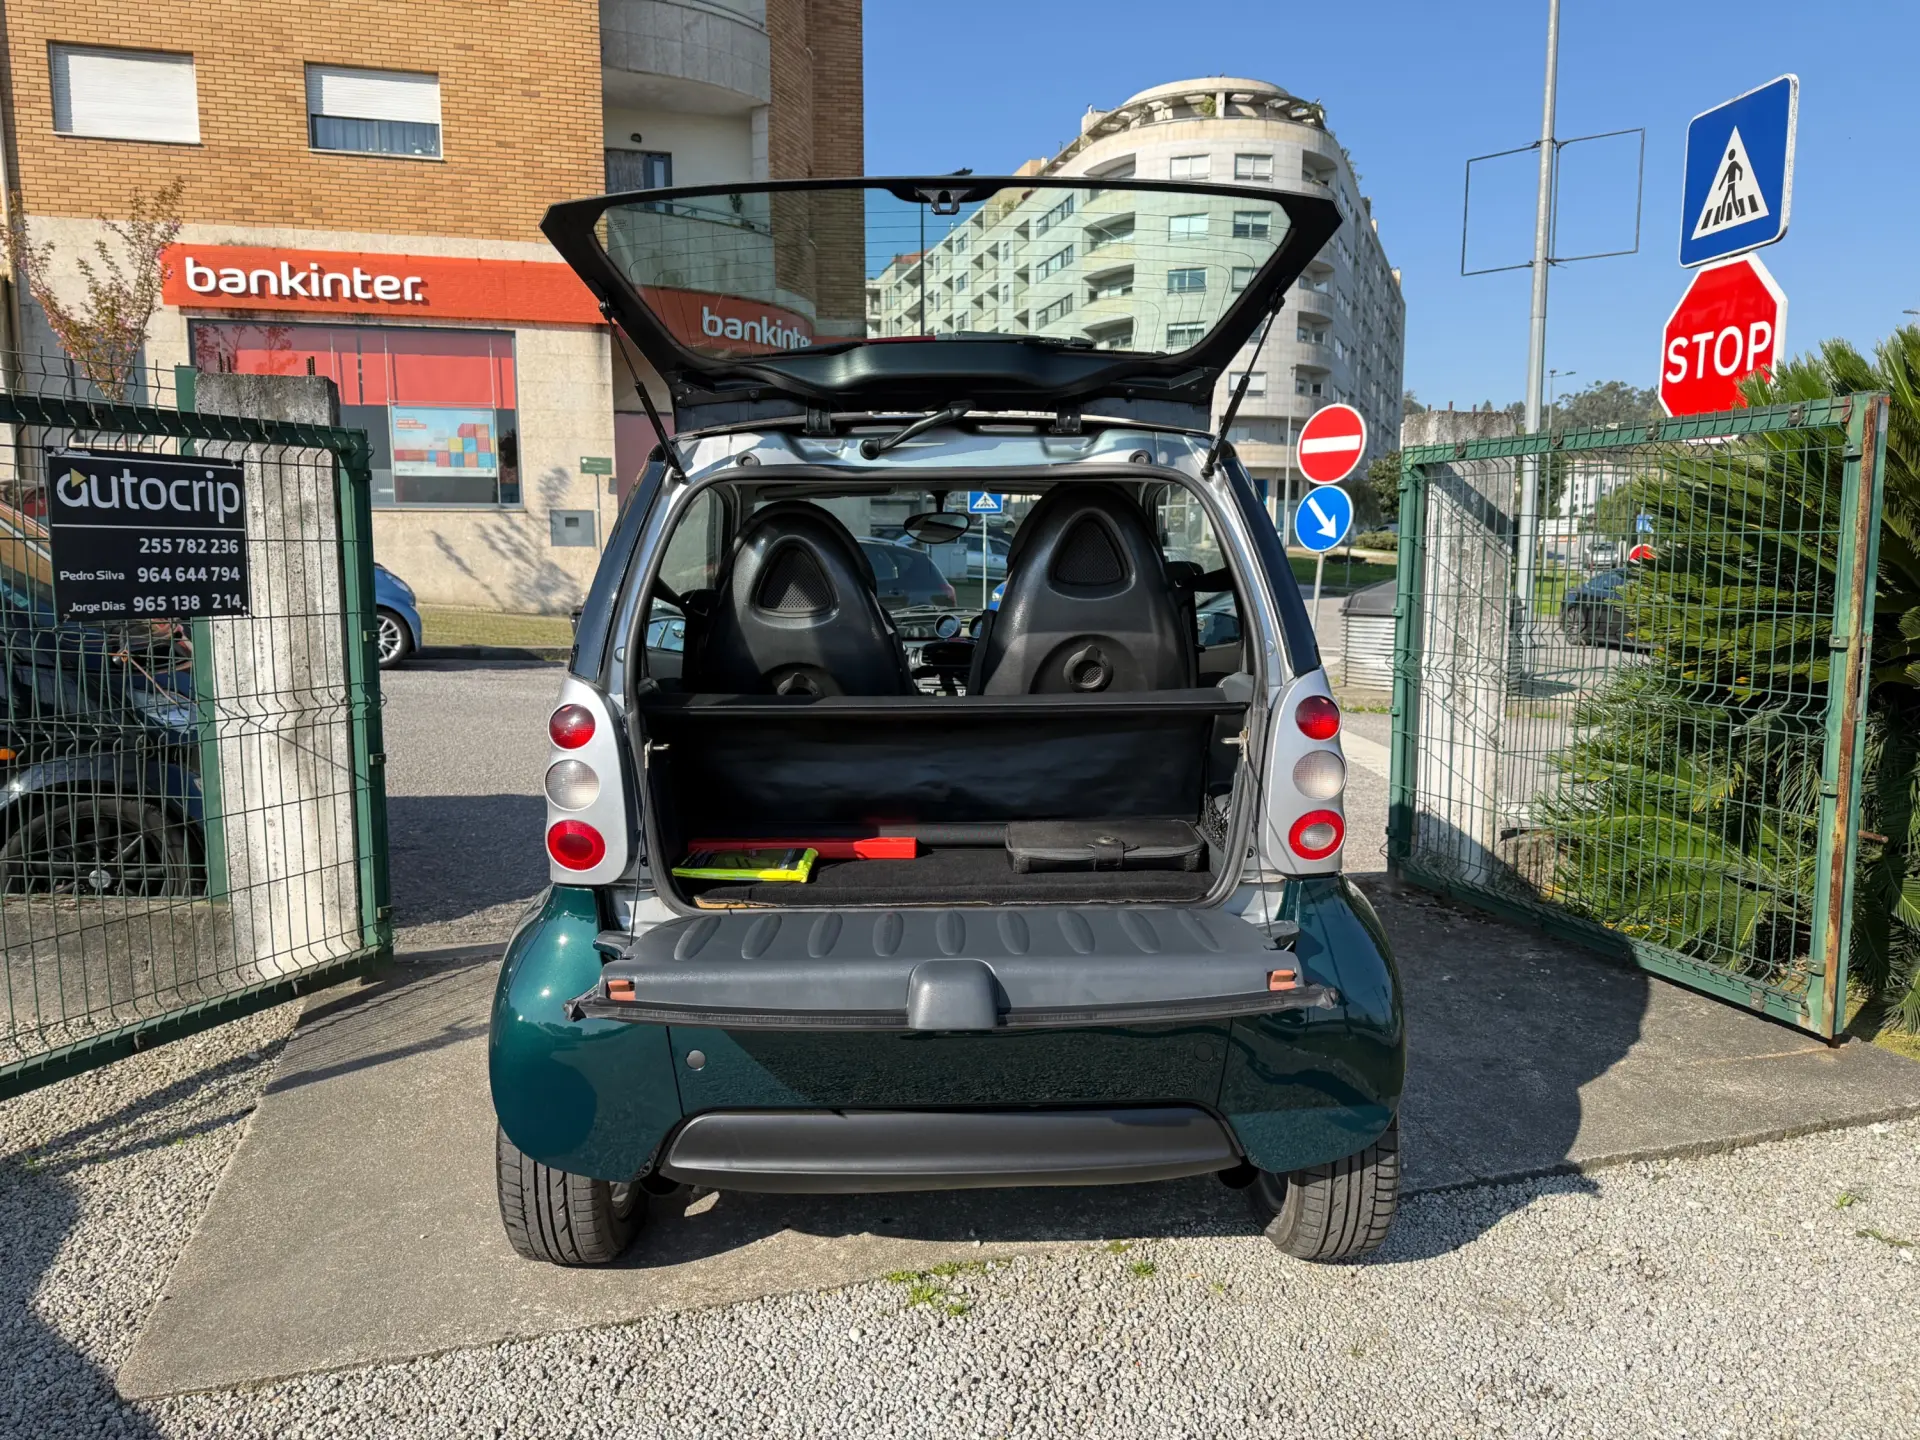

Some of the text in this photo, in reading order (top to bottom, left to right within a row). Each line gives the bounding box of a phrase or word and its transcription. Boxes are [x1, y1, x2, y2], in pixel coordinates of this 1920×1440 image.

[1665, 320, 1772, 384] STOP
[56, 467, 240, 524] autocrip
[139, 538, 239, 554] 255 782 236
[60, 566, 241, 583] Pedro Silva 964 644 794
[69, 593, 242, 614] Jorge Dias 965 138 214
